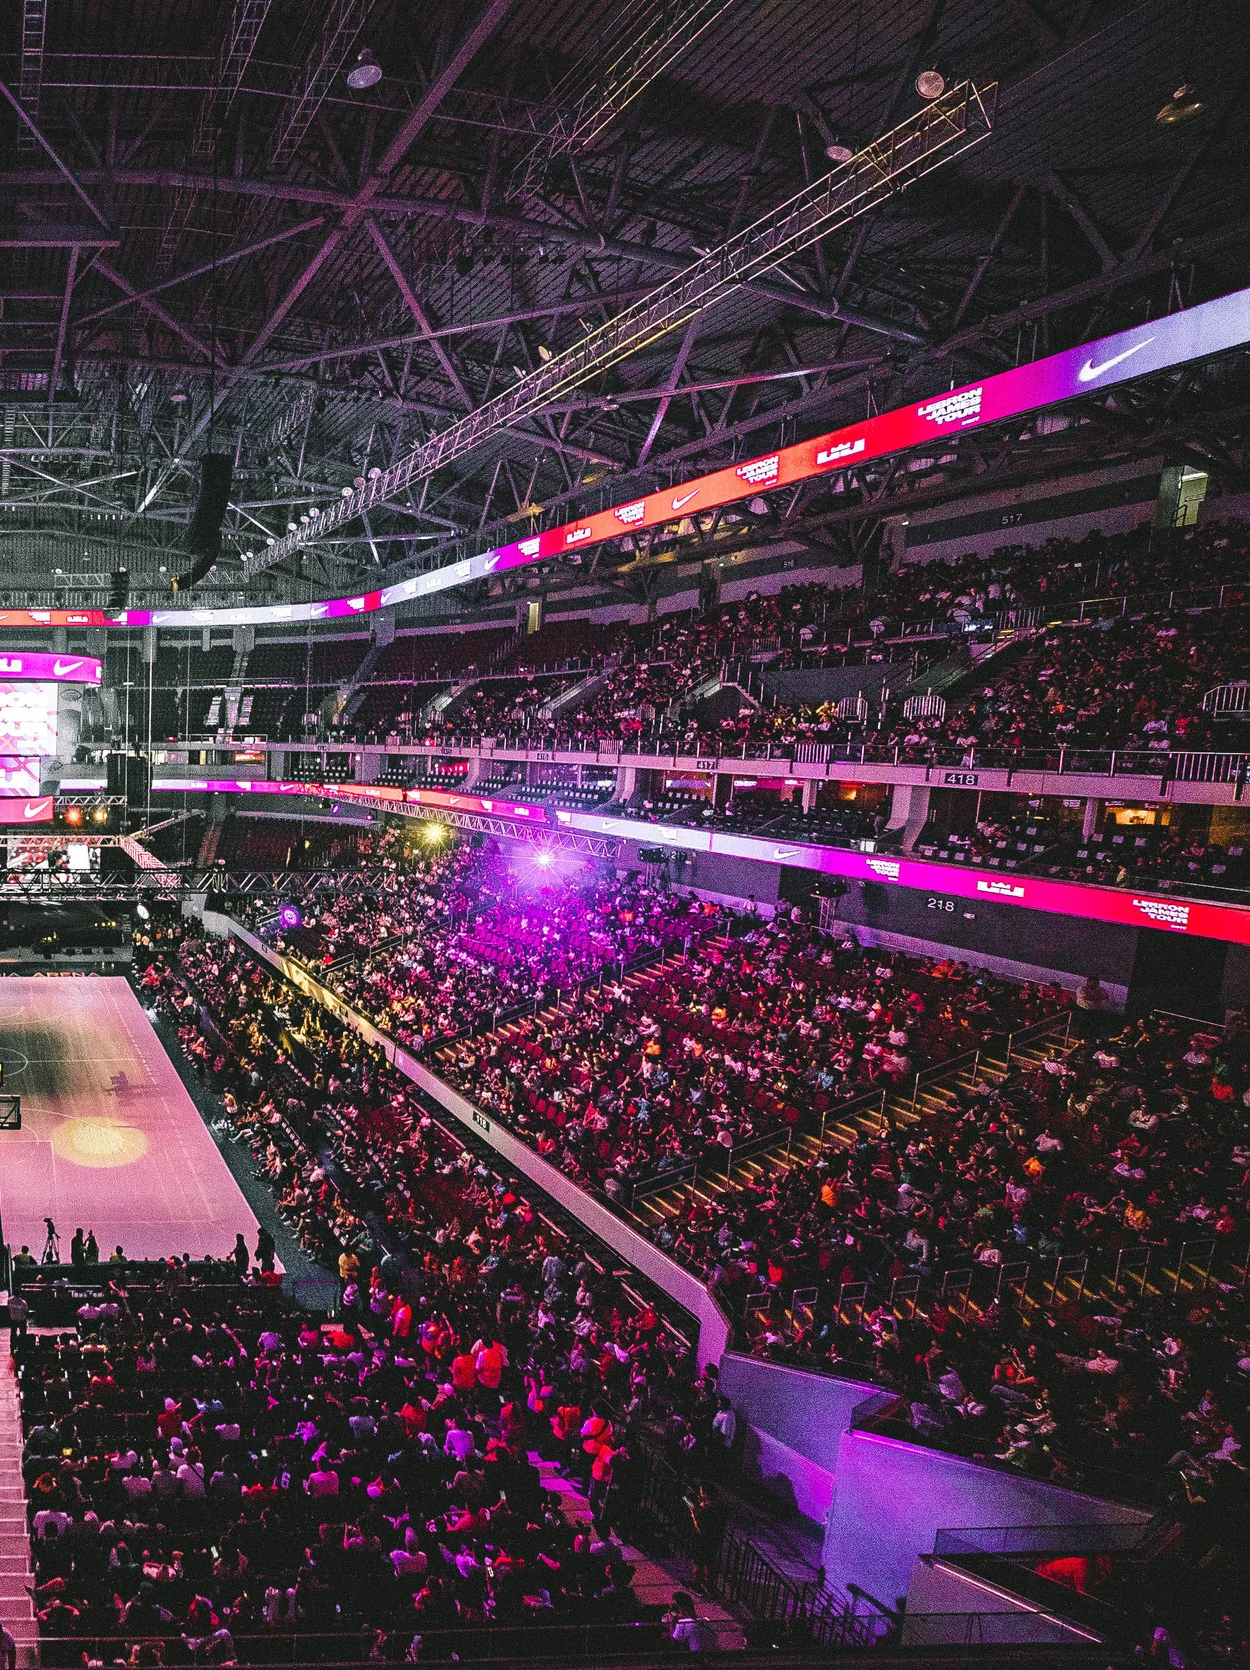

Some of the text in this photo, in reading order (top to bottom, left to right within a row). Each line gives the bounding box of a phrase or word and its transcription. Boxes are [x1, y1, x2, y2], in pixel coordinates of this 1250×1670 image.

[917, 386, 983, 417] LEBRON
[925, 395, 982, 421] JAMES
[934, 404, 981, 425] TOUR
[1001, 512, 1023, 525] 517
[947, 774, 976, 785] 418
[927, 897, 955, 912] 218
[1132, 899, 1190, 914] LEBRON
[1139, 906, 1189, 919] JAMES
[1147, 912, 1188, 925] TOUR
